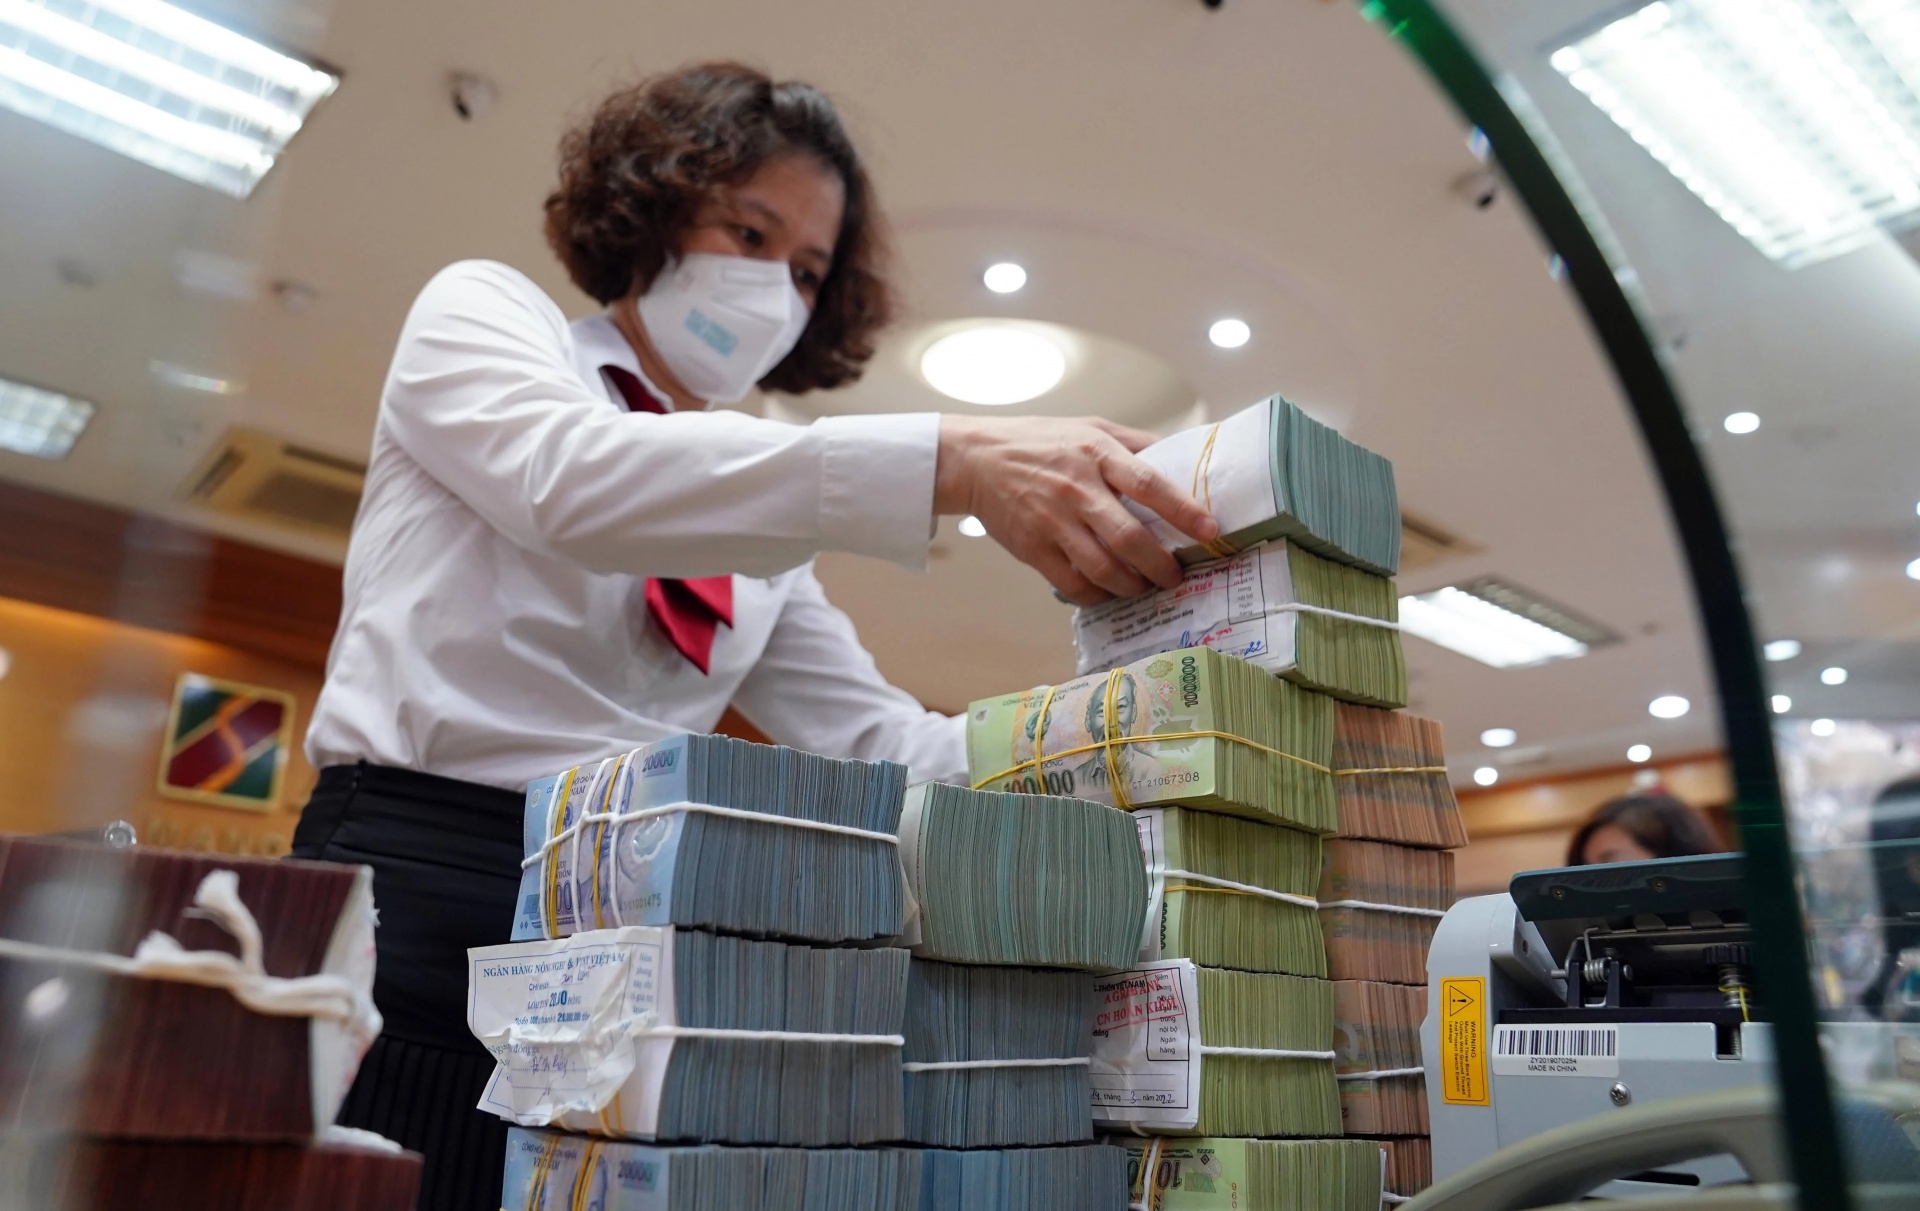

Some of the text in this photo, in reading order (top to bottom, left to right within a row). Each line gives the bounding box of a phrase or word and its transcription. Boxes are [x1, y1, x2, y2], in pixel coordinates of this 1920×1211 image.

[1181, 655, 1199, 708] 100000
[641, 750, 675, 772] 20000
[1132, 771, 1200, 789] CT 21067308
[1104, 979, 1162, 1005] AGRIBANK
[1096, 1012, 1111, 1026] CN
[1170, 1025, 1178, 1033] bộ
[1160, 1036, 1176, 1045] Ngân
[1159, 1046, 1176, 1055] hàng
[1527, 1064, 1578, 1073] MADE IN CHINA
[1104, 1093, 1121, 1102] tháng
